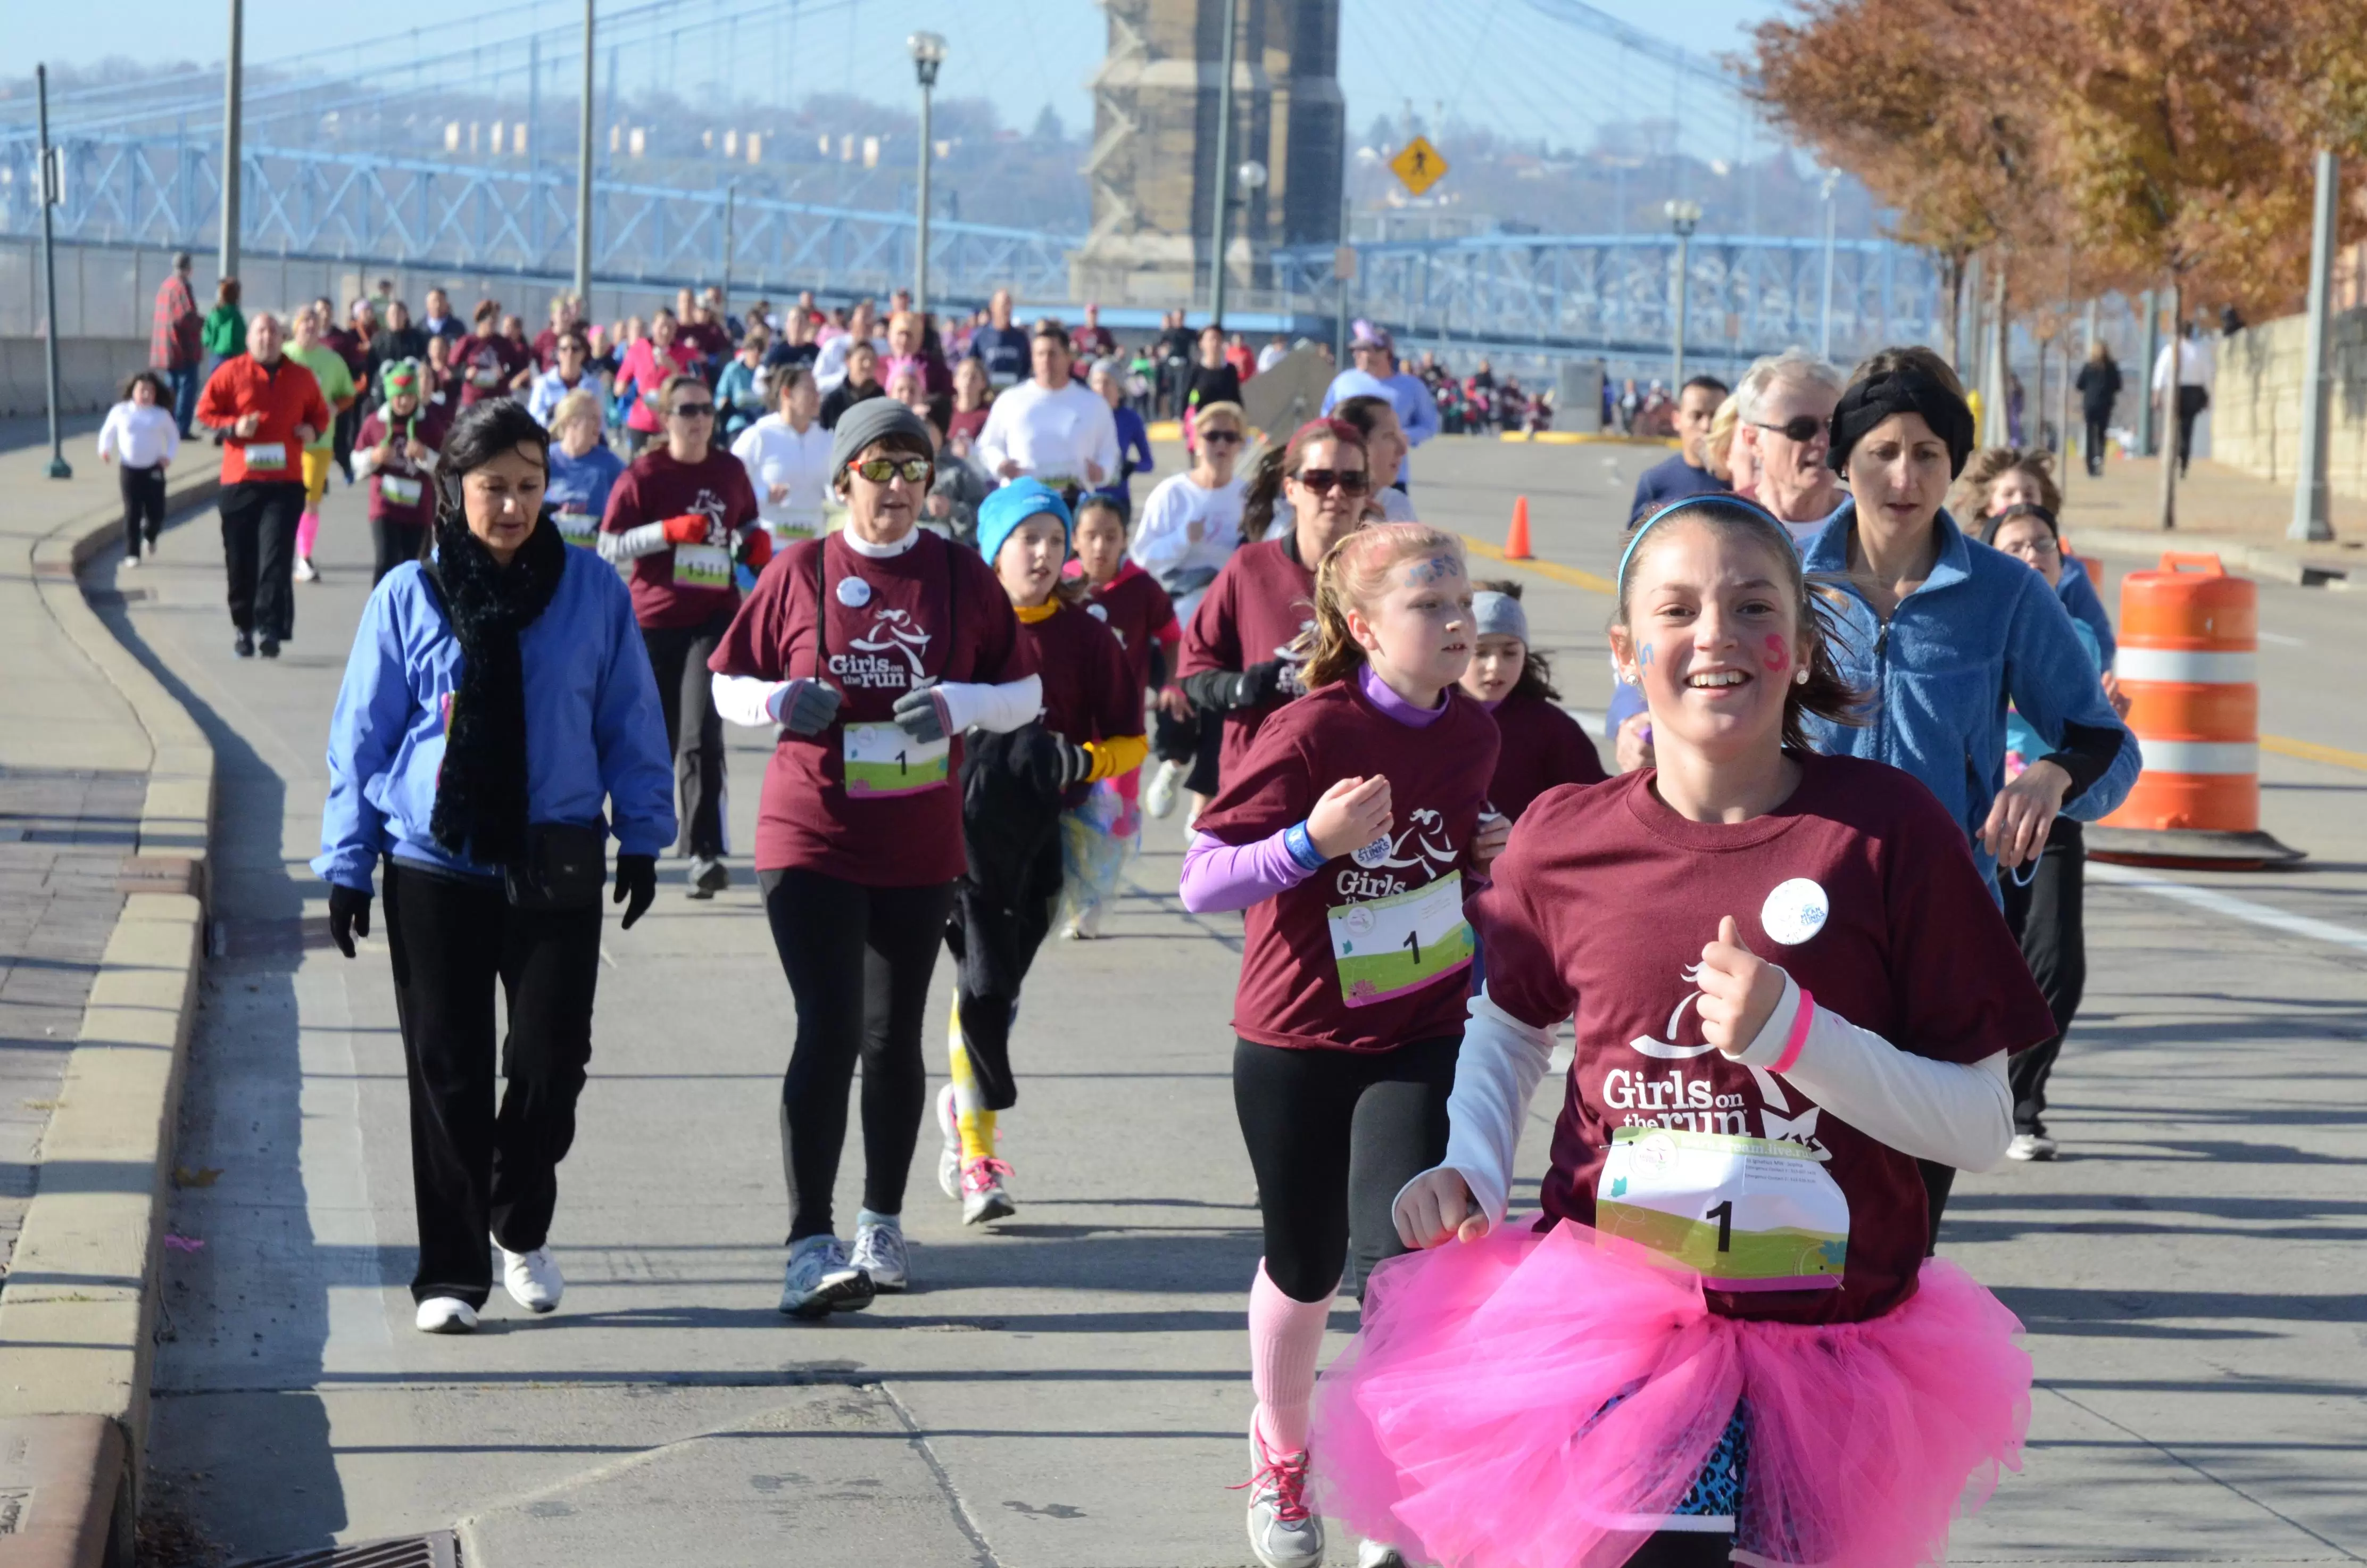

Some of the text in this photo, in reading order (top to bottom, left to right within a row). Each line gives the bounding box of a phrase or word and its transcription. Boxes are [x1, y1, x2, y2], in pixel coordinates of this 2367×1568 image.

[687, 560, 722, 578] 1311
[828, 654, 889, 674] Girls
[860, 673, 906, 688] run
[894, 750, 907, 775] 1
[1358, 841, 1390, 861] STINKS
[1336, 869, 1406, 897] Girls
[1345, 896, 1360, 905] th
[1403, 931, 1420, 964] 1
[1602, 1069, 1745, 1109] Girls on
[1705, 1200, 1733, 1252] 1
